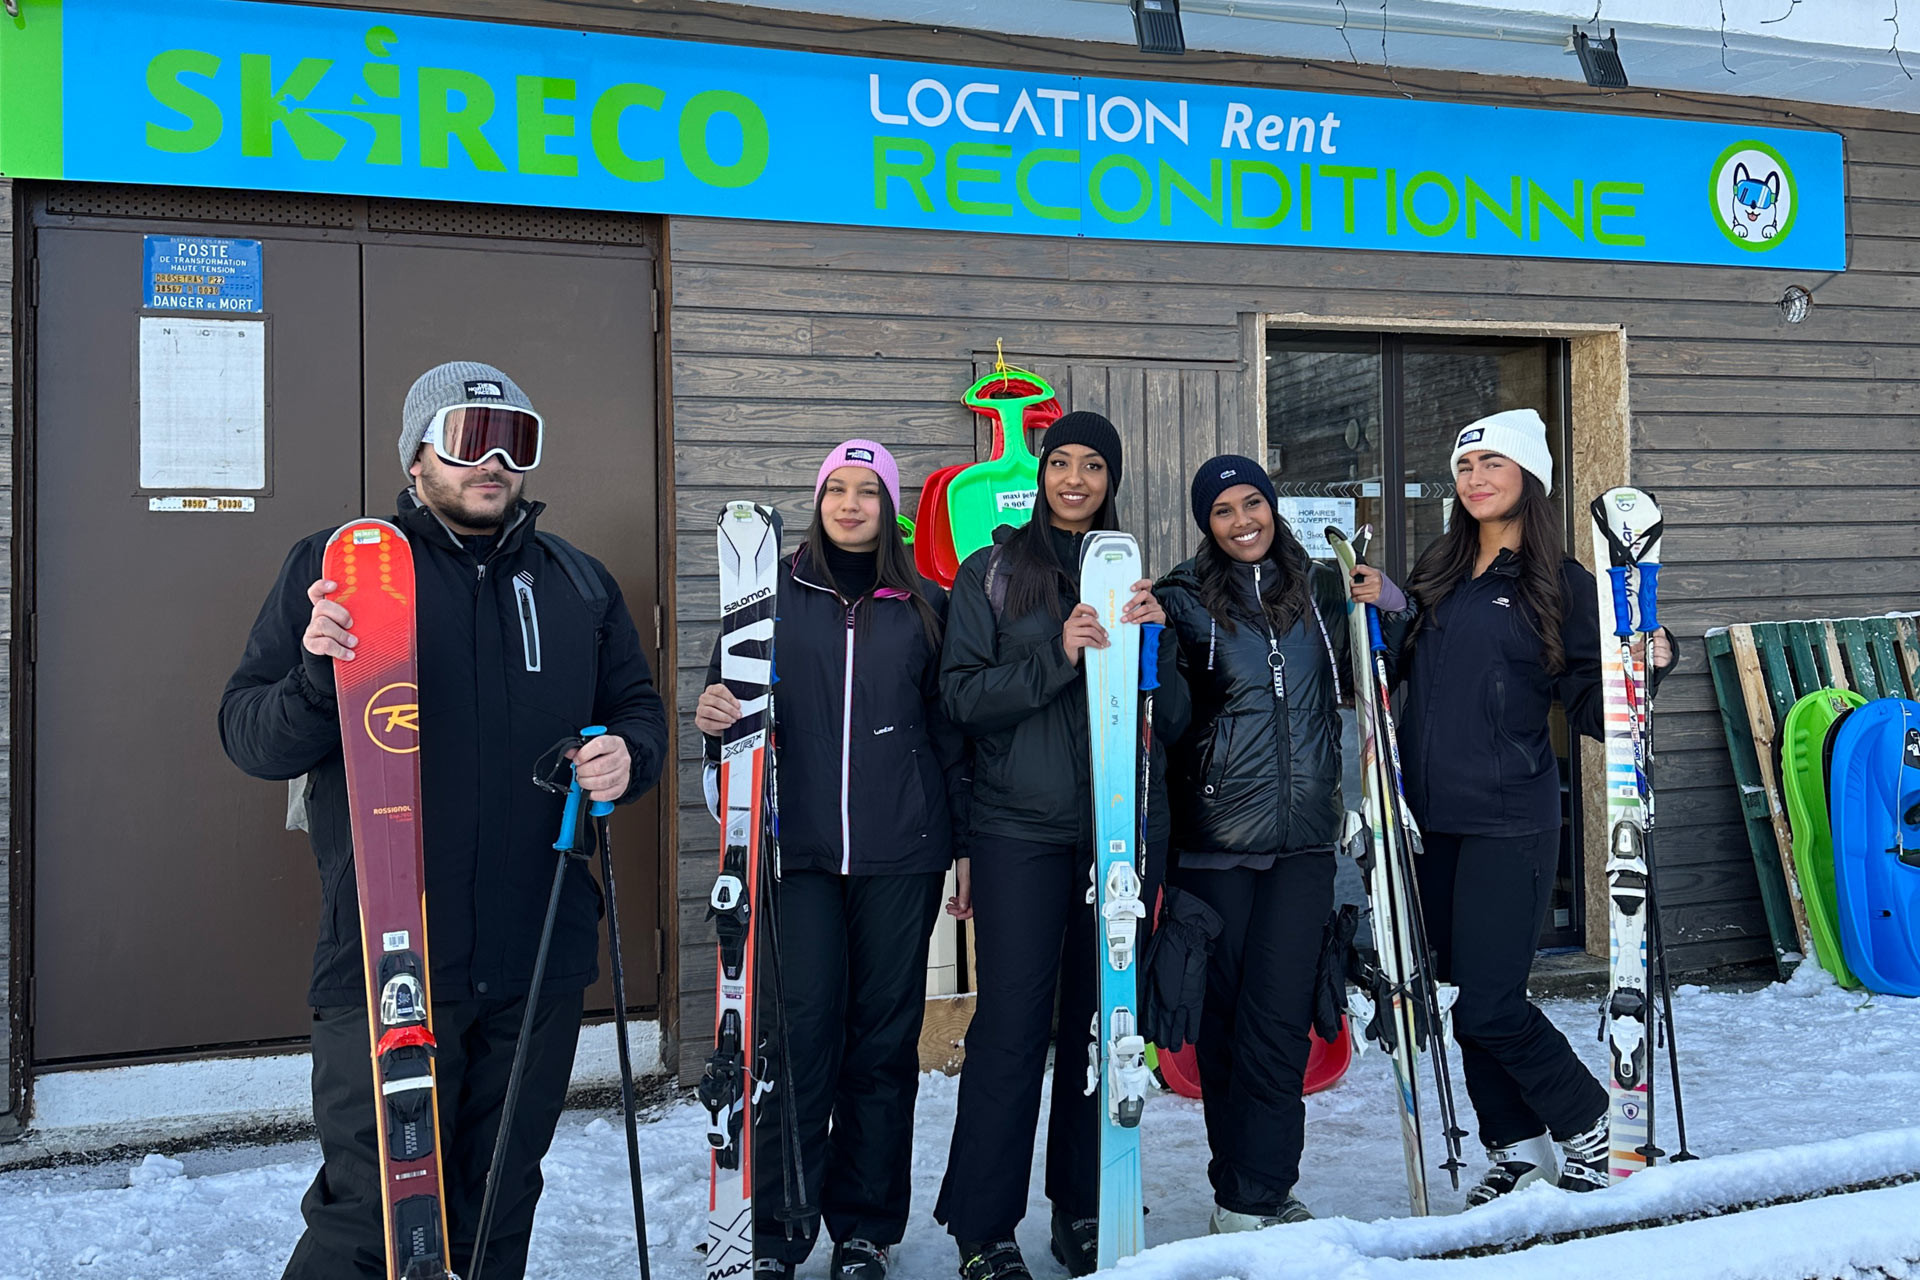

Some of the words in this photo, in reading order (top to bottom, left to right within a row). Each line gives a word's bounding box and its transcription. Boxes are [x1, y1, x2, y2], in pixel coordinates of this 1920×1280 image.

[869, 73, 1189, 146] LOCATION
[1220, 101, 1342, 155] Rent
[873, 135, 1646, 247] RECONDITIONNE
[178, 243, 229, 258] POSTE
[174, 257, 247, 267] TRANSFORMATION
[201, 265, 236, 274] TENSION
[153, 295, 204, 308] DANGER
[220, 298, 253, 310] MORT
[1622, 650, 1630, 664] 115
[373, 805, 412, 815] ROSSIGNOL
